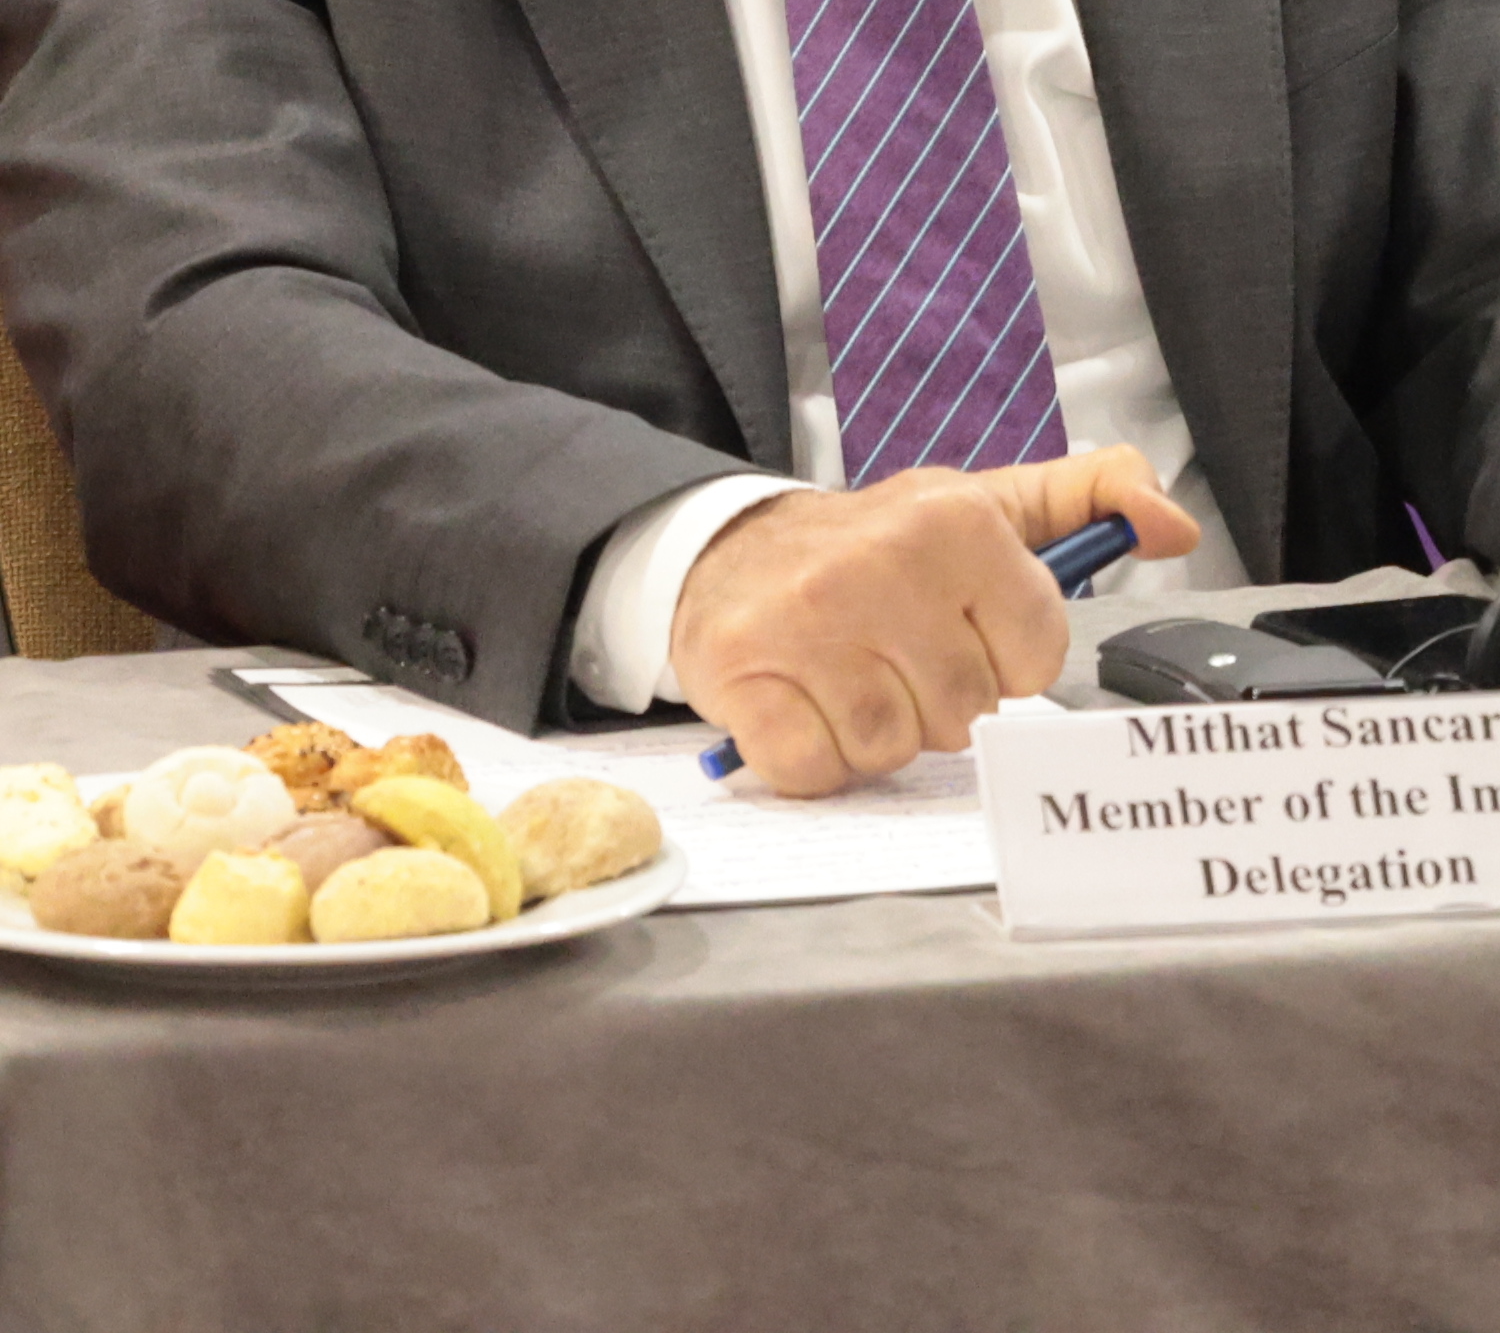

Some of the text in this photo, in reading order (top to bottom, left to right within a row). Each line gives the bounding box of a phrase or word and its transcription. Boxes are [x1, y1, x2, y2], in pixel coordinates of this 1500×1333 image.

[1126, 712, 1305, 758] Mithat
[1038, 786, 1264, 834] Member
[1283, 779, 1334, 822] of
[1350, 778, 1430, 818] the
[1199, 850, 1478, 904] Delegation
